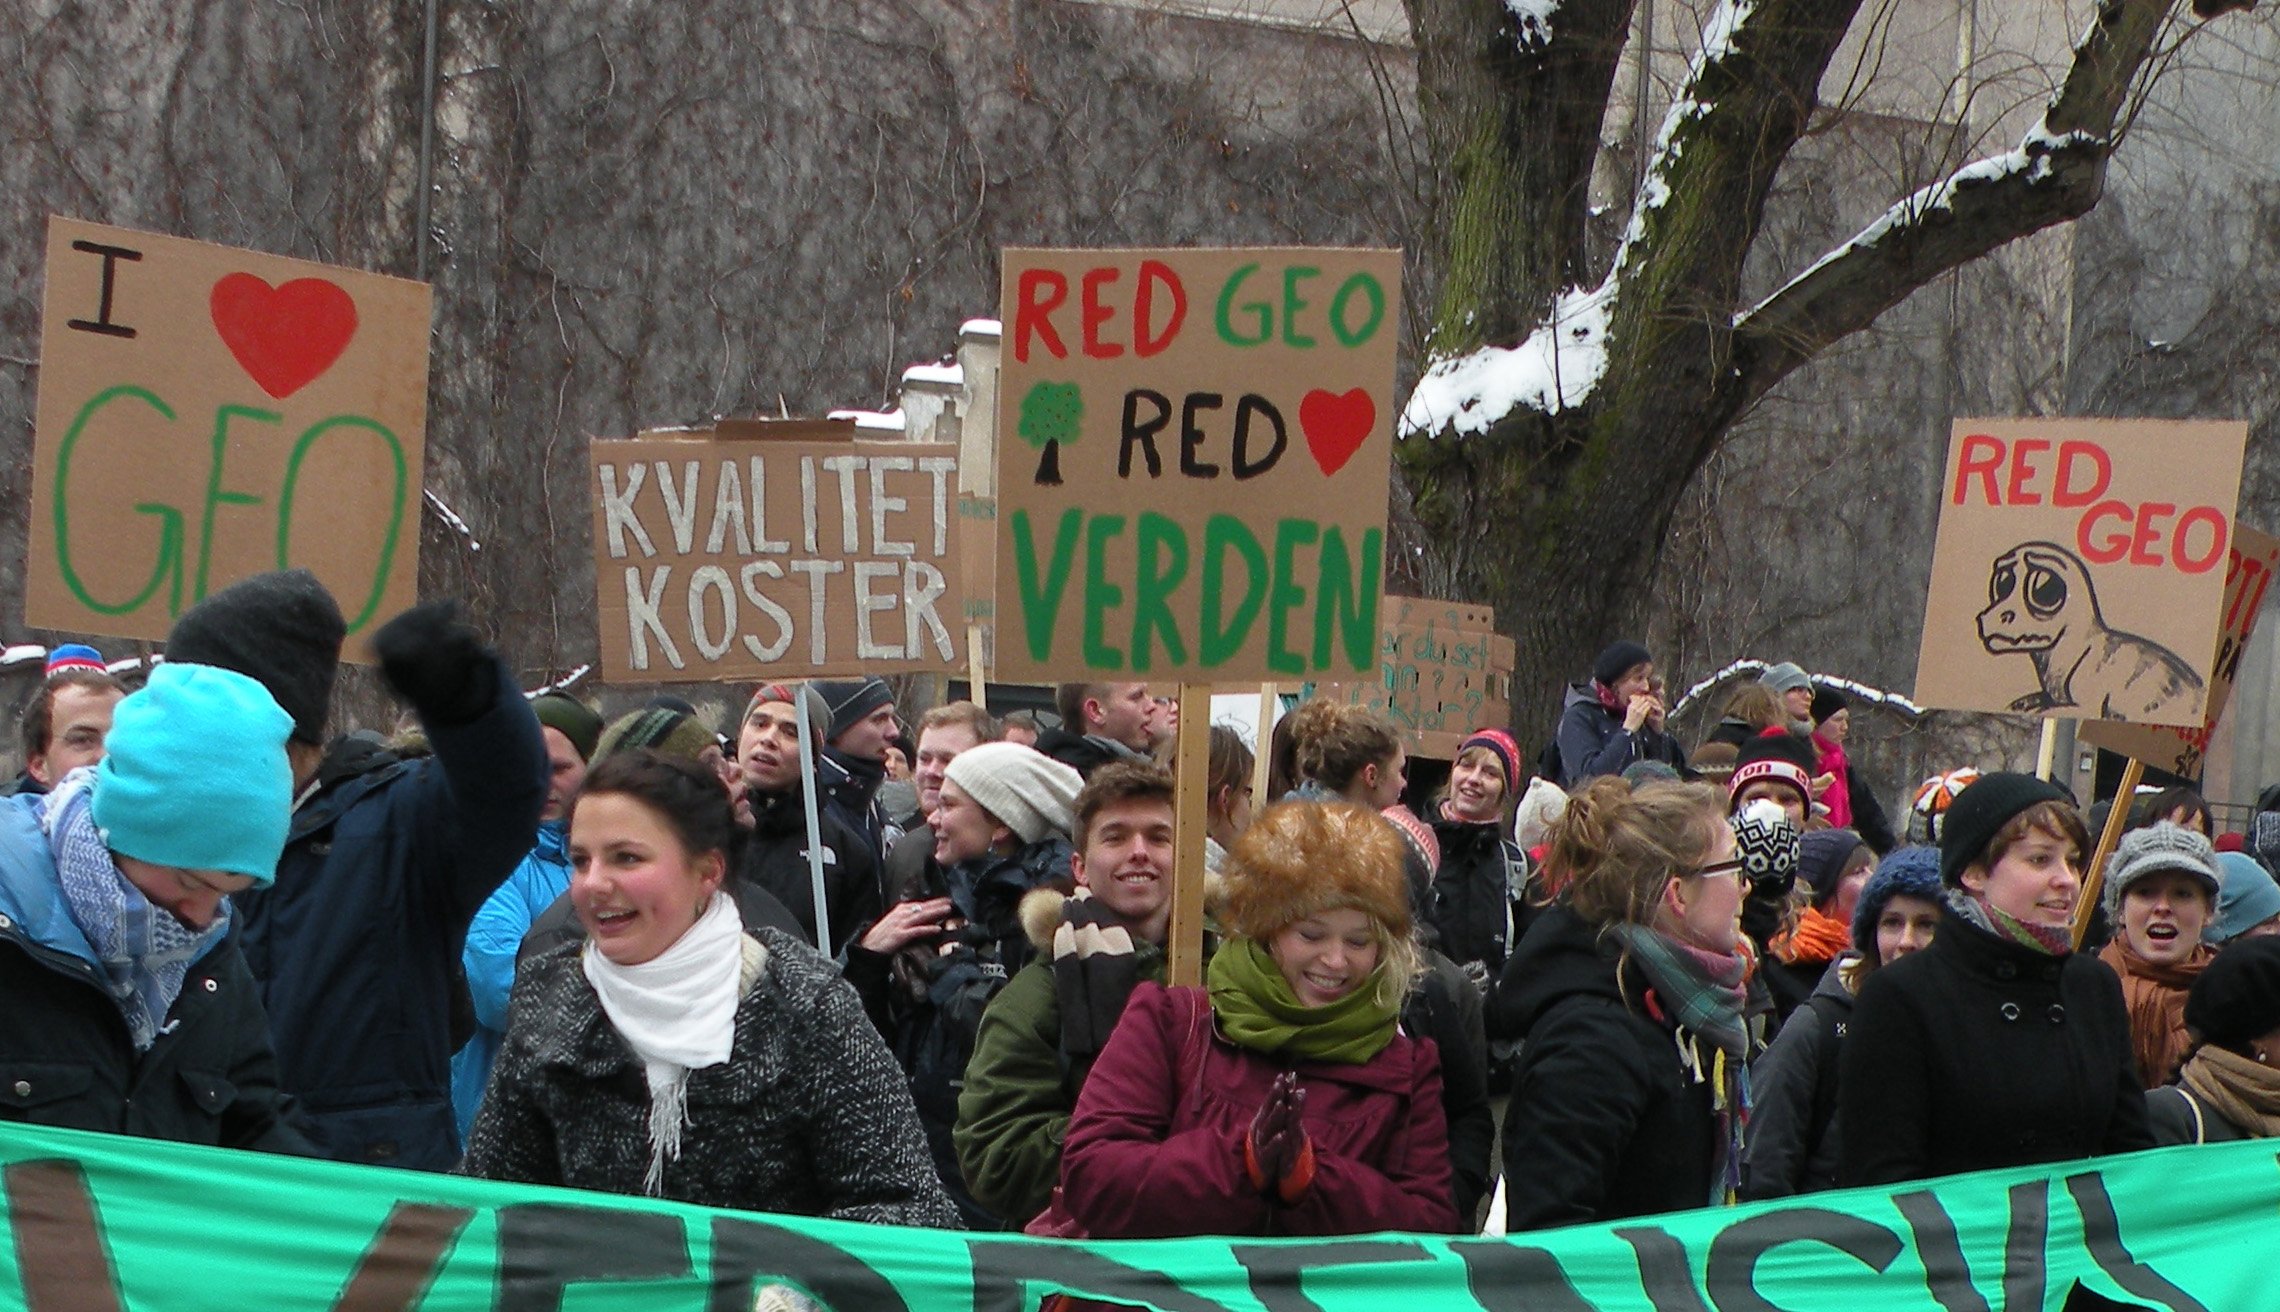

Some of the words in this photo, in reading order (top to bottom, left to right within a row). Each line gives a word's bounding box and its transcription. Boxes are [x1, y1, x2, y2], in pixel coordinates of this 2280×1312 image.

[67, 240, 142, 338] I
[1014, 259, 1188, 363] RED
[1214, 262, 1386, 349] GEO
[1118, 389, 1287, 480] RED
[1952, 433, 2112, 507] RED
[53, 384, 407, 636] GEO
[598, 456, 957, 558] KVALITET
[2076, 499, 2228, 574] GEO
[625, 556, 954, 670] KOSTER
[1010, 507, 1383, 675] VERDEN
